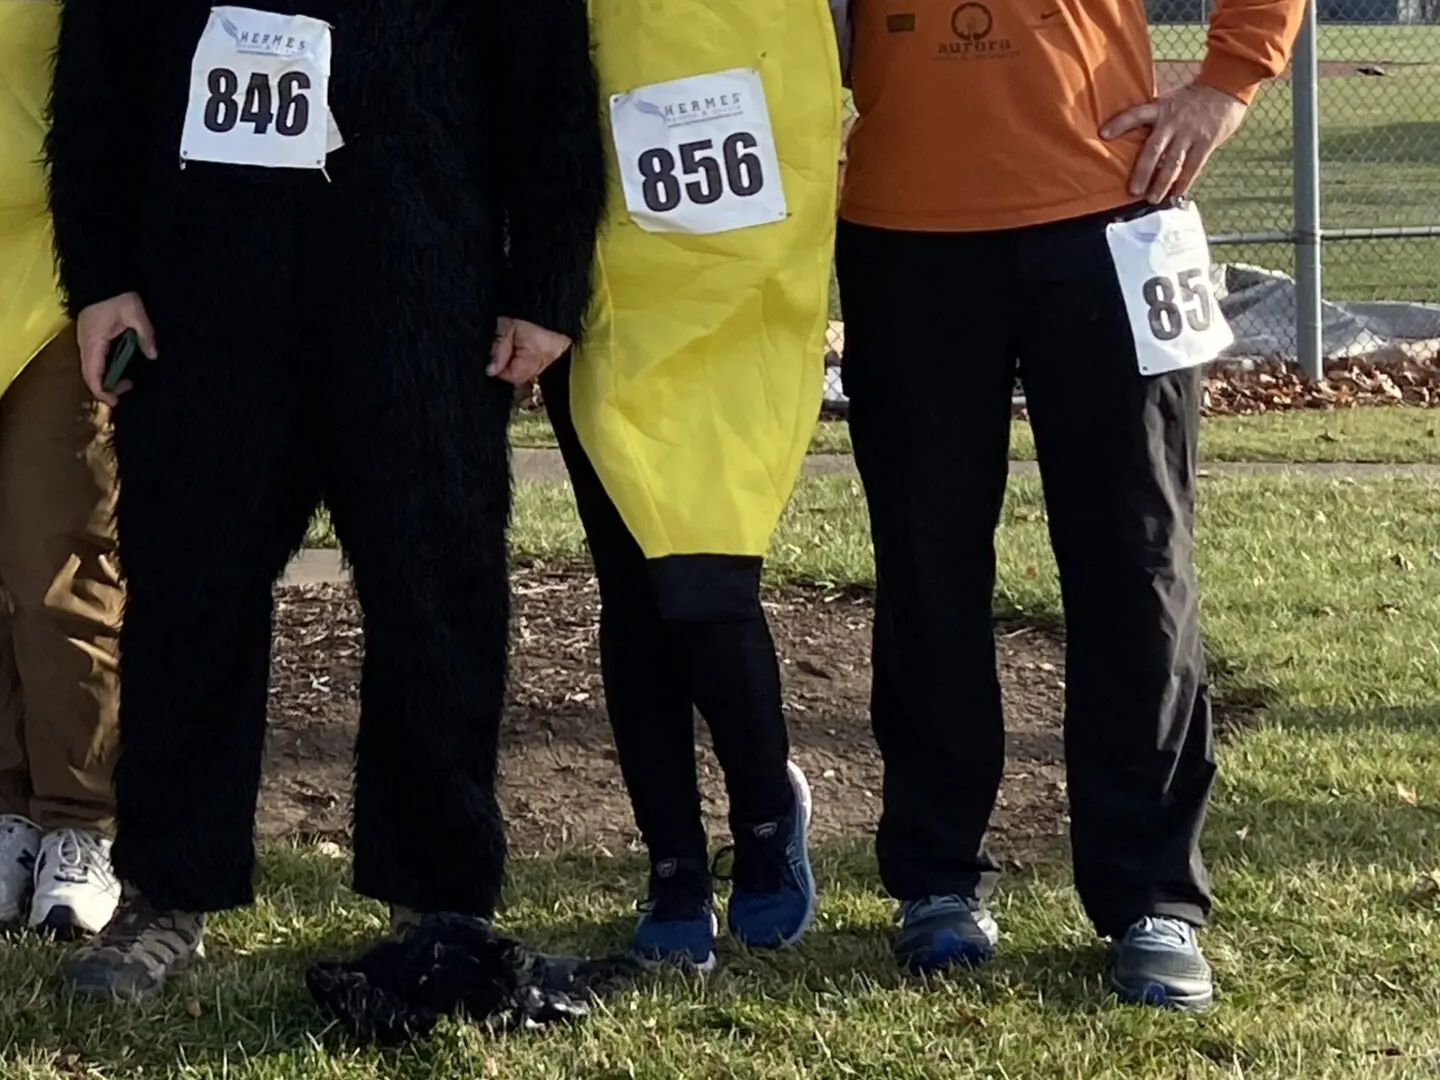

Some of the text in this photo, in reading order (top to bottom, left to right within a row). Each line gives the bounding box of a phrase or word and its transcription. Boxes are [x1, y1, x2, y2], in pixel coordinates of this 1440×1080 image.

[240, 31, 306, 49] HERMES
[937, 38, 1012, 54] aurora
[203, 67, 311, 137] 846
[663, 92, 742, 117] HERMES
[637, 131, 764, 213] 856
